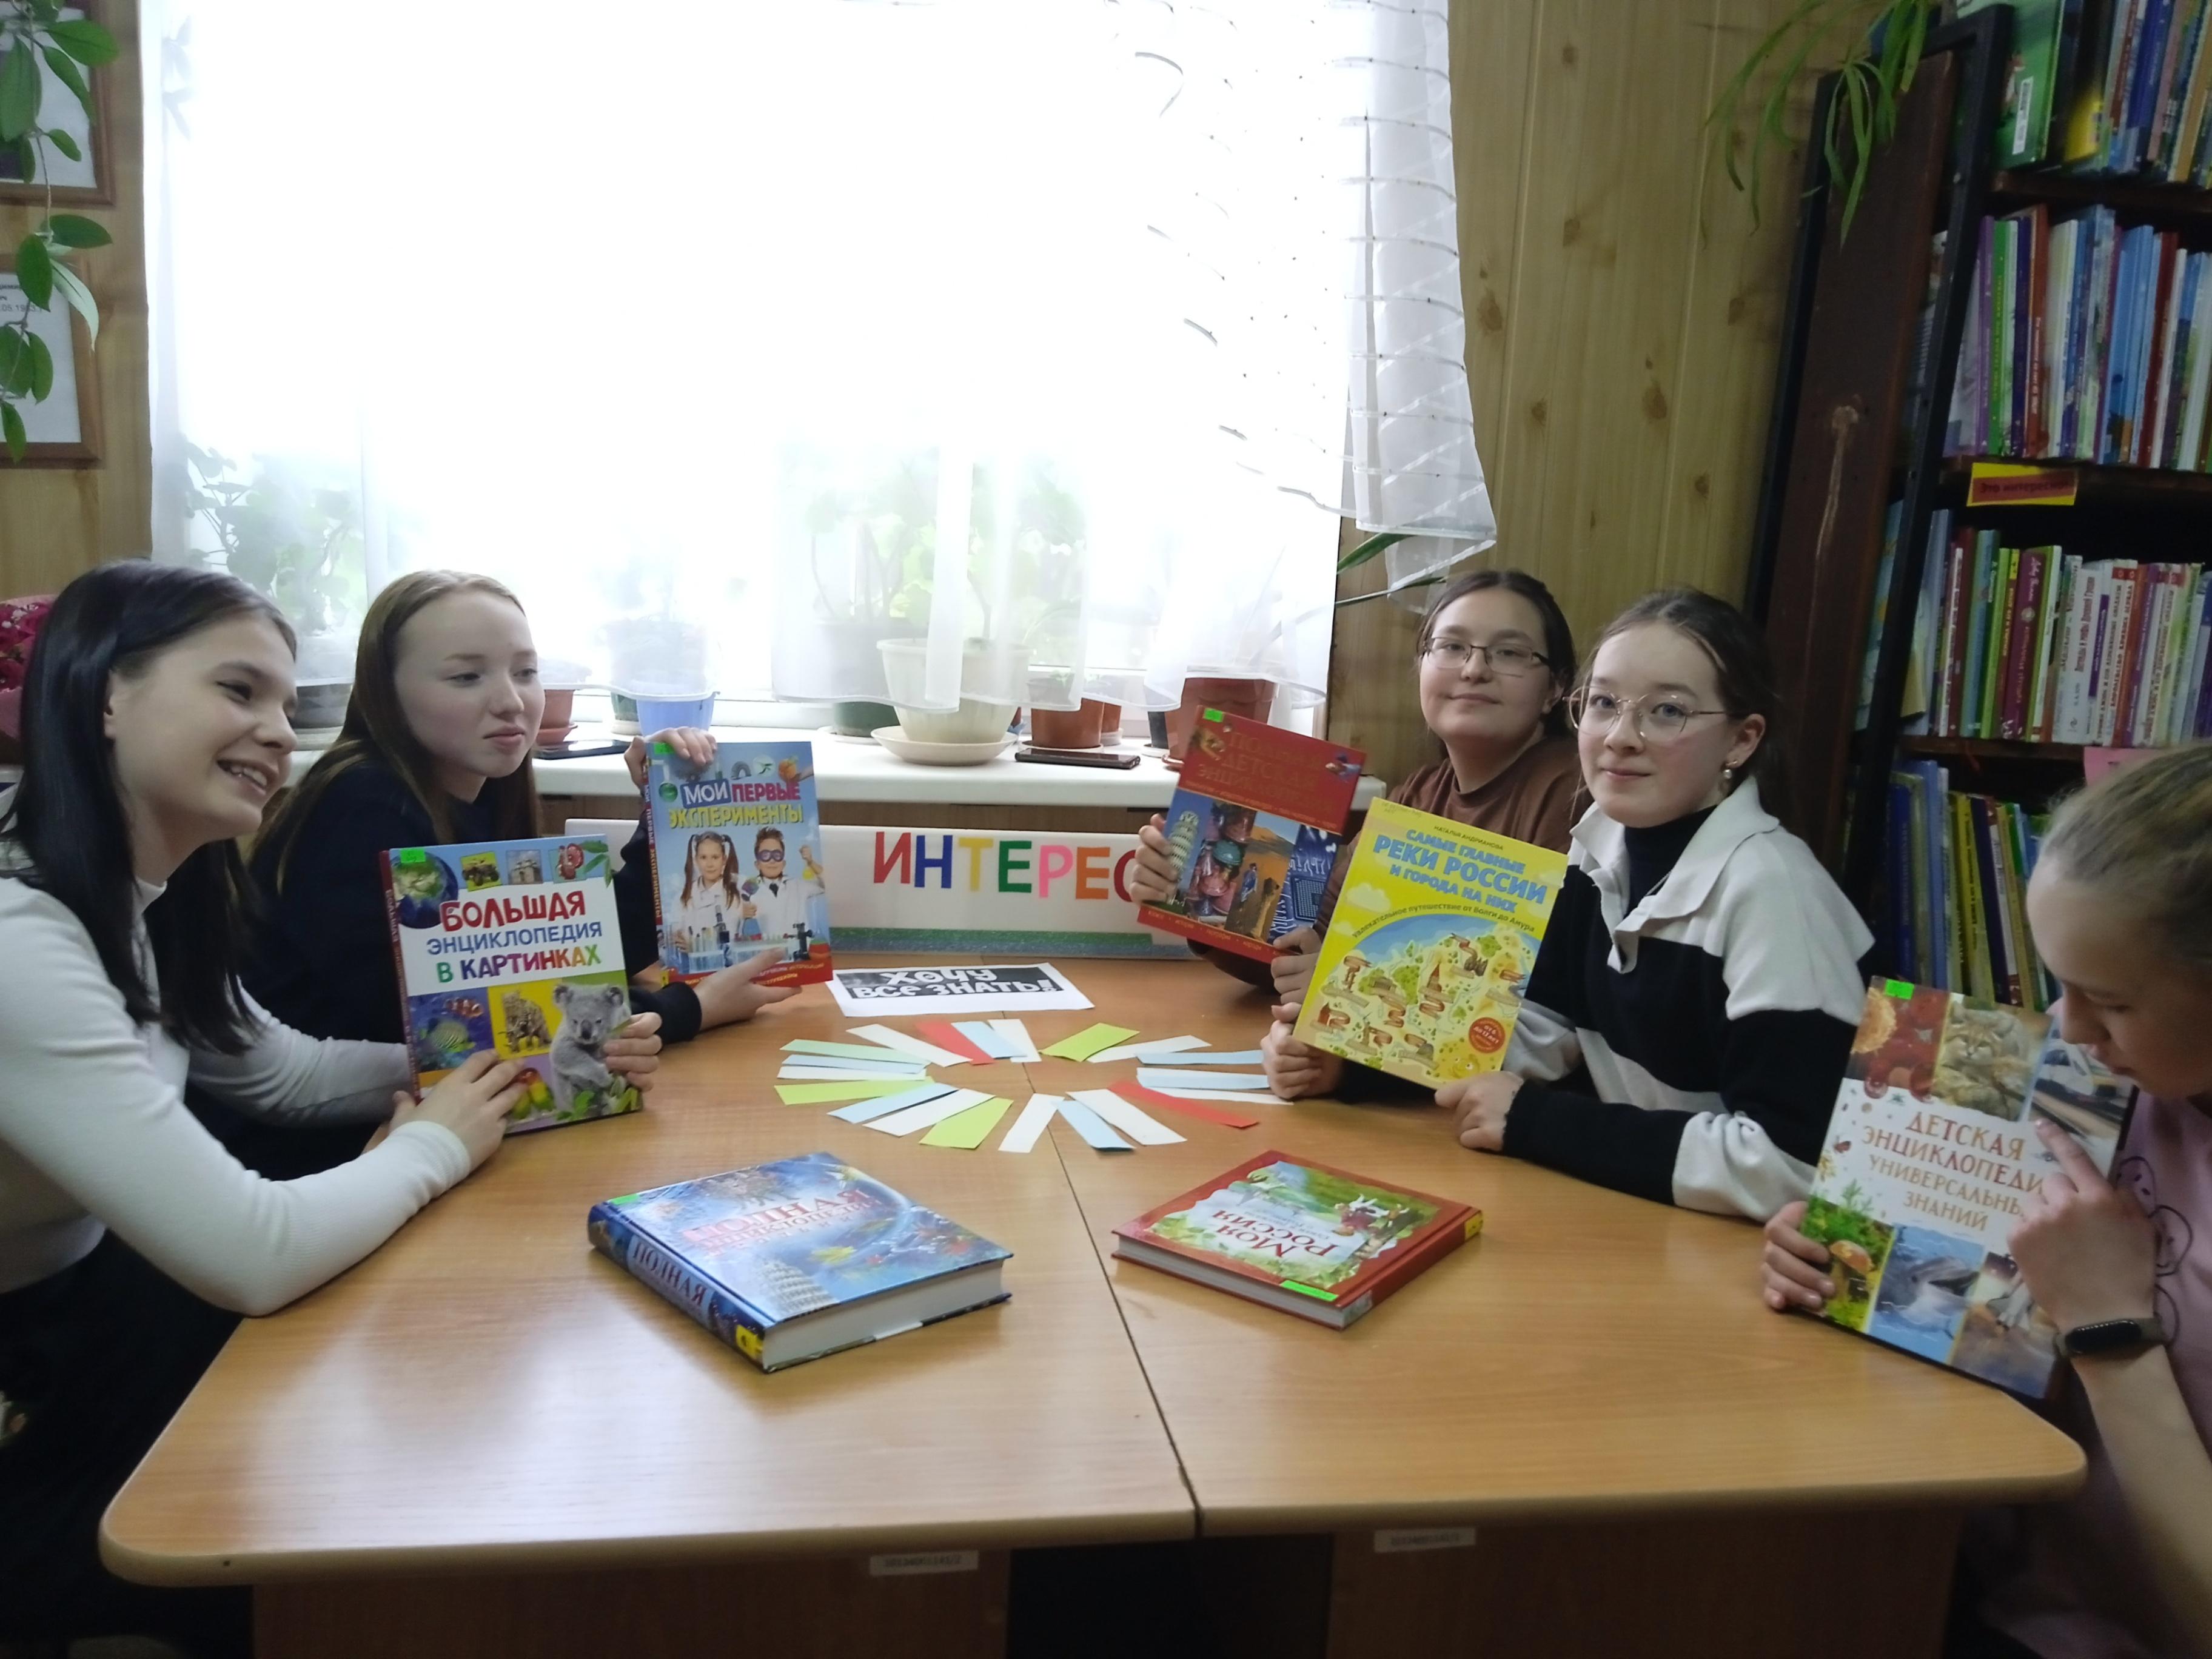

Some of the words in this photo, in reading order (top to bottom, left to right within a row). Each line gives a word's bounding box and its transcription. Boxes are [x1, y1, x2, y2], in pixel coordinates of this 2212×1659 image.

[683, 781, 728, 805] МОИ
[731, 782, 802, 803] ПЕРВЫЕ
[646, 808, 655, 845] ПЕРВЫЕ
[670, 803, 804, 829] ЭКСПЕРИМЕНТЫ
[1406, 828, 1458, 854] САМЫЕ
[1458, 845, 1526, 874] ГЛАВНЫЕ
[1433, 825, 1461, 837] НАТАЛЬЯ
[1461, 833, 1504, 851] АНДРИАНОВА
[650, 847, 663, 919] ЭКСПЕРИМЕНТЫ
[1372, 834, 1438, 870] РЕКИ
[1443, 856, 1549, 905] РОССИИ
[1389, 863, 1402, 876] И
[1403, 866, 1459, 896] ГОРОДА
[1461, 887, 1483, 903] НА
[1486, 894, 1520, 914] НИХ
[439, 890, 586, 932] БОЛЬШАЯ
[1408, 902, 1462, 913] путешествие
[1462, 904, 1472, 913] от
[1473, 905, 1498, 920] Волги
[1498, 913, 1509, 922] до
[1509, 917, 1536, 933] Амура
[426, 921, 603, 955] ЭНЦИКЛОПЕДИЯ
[436, 961, 454, 984] В
[461, 944, 602, 980] КАРТИНКАХ
[1905, 1111, 2025, 1161] ДЕТСКАЯ
[1862, 1125, 2045, 1193] ЭНЦИКЛОПЕДИ
[682, 1188, 871, 1242] ПОЛНАЯ
[1903, 1190, 1988, 1232] ЗНАНИЙ
[633, 1243, 707, 1306] ПОЛНАЯ
